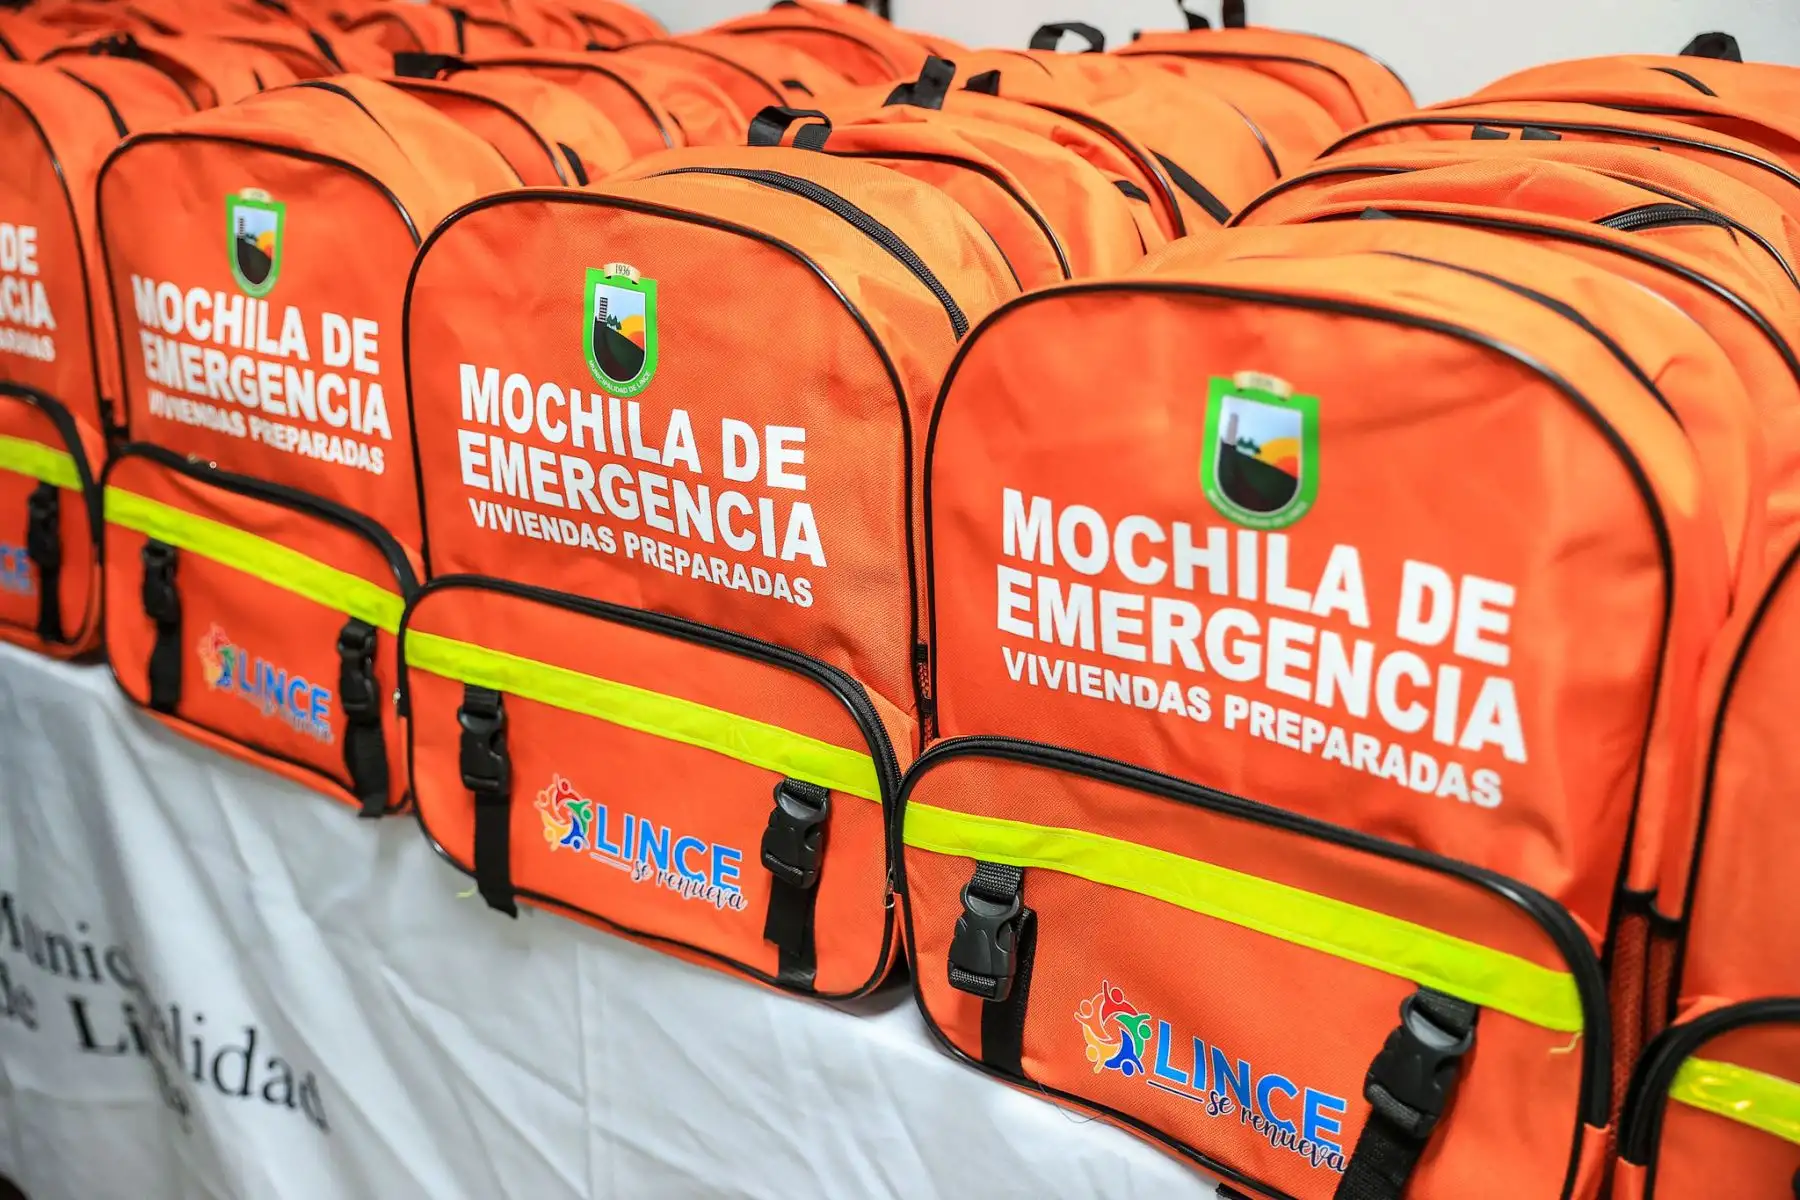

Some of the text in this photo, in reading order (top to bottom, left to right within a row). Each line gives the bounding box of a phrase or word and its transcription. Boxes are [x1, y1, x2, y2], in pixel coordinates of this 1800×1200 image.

[0, 223, 38, 275] DE
[615, 264, 631, 276] 1936
[0, 275, 57, 330] CIA
[132, 274, 309, 362] MOCHILA
[322, 313, 379, 375] DE
[139, 329, 392, 440] EMERGENCIA
[148, 389, 384, 475] VIVIENDAS PREPARADAS
[459, 363, 807, 491] MOCHILA DE
[457, 428, 828, 568] EMERGENCIA
[468, 497, 814, 608] VIVIENDAS PREPARADAS
[1002, 487, 1516, 667] MOCHILA DE
[238, 648, 332, 730] LINCE
[996, 563, 1528, 764] EMERGENCIA
[1001, 645, 1503, 809] VIVIENDAS PREPARADAS
[595, 803, 743, 894] LINCE
[631, 860, 748, 911] se renueva
[1153, 1019, 1347, 1154] LINCE
[1205, 1090, 1348, 1173] se renueva
